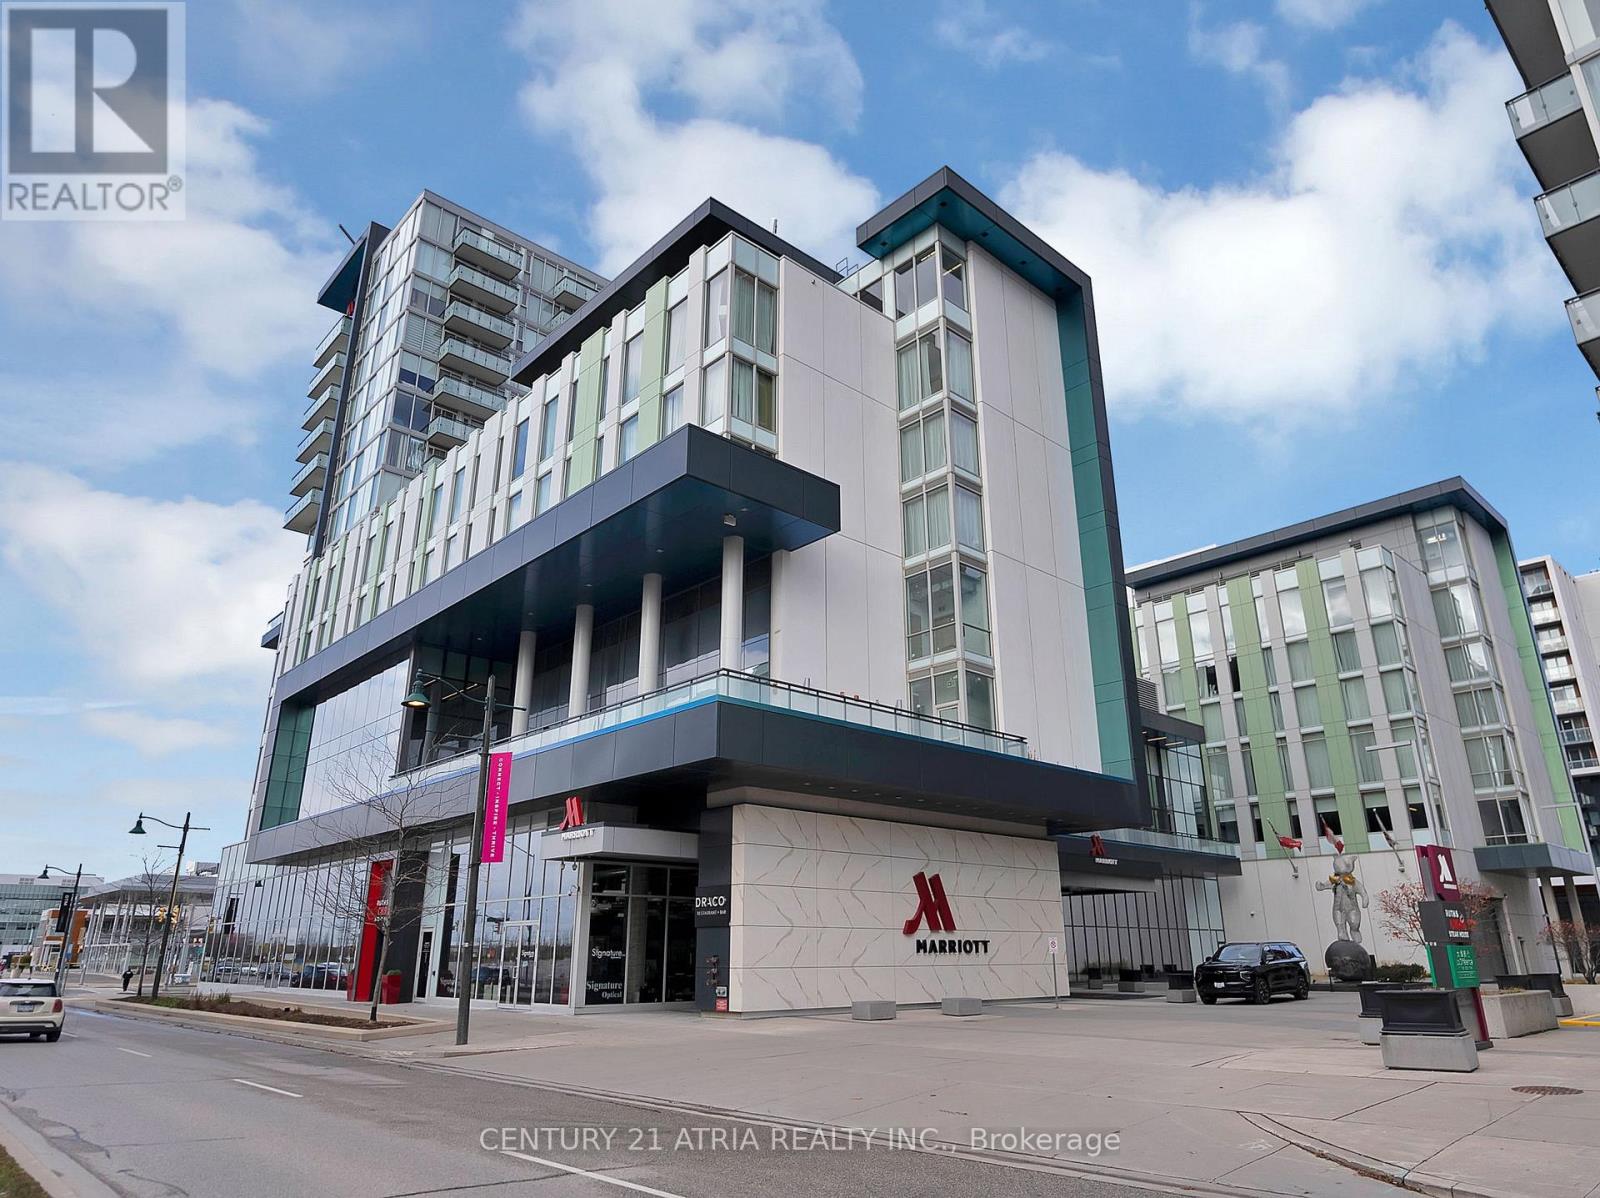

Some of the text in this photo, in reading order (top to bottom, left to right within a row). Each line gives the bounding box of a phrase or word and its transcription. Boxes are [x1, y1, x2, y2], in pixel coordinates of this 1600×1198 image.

[489, 758, 504, 858] CONNECT INSPIRE THRIVE
[695, 896, 725, 908] DRACO
[916, 939, 991, 954] MARRIOTT
[591, 947, 623, 960] Signature
[586, 980, 623, 992] Signature
